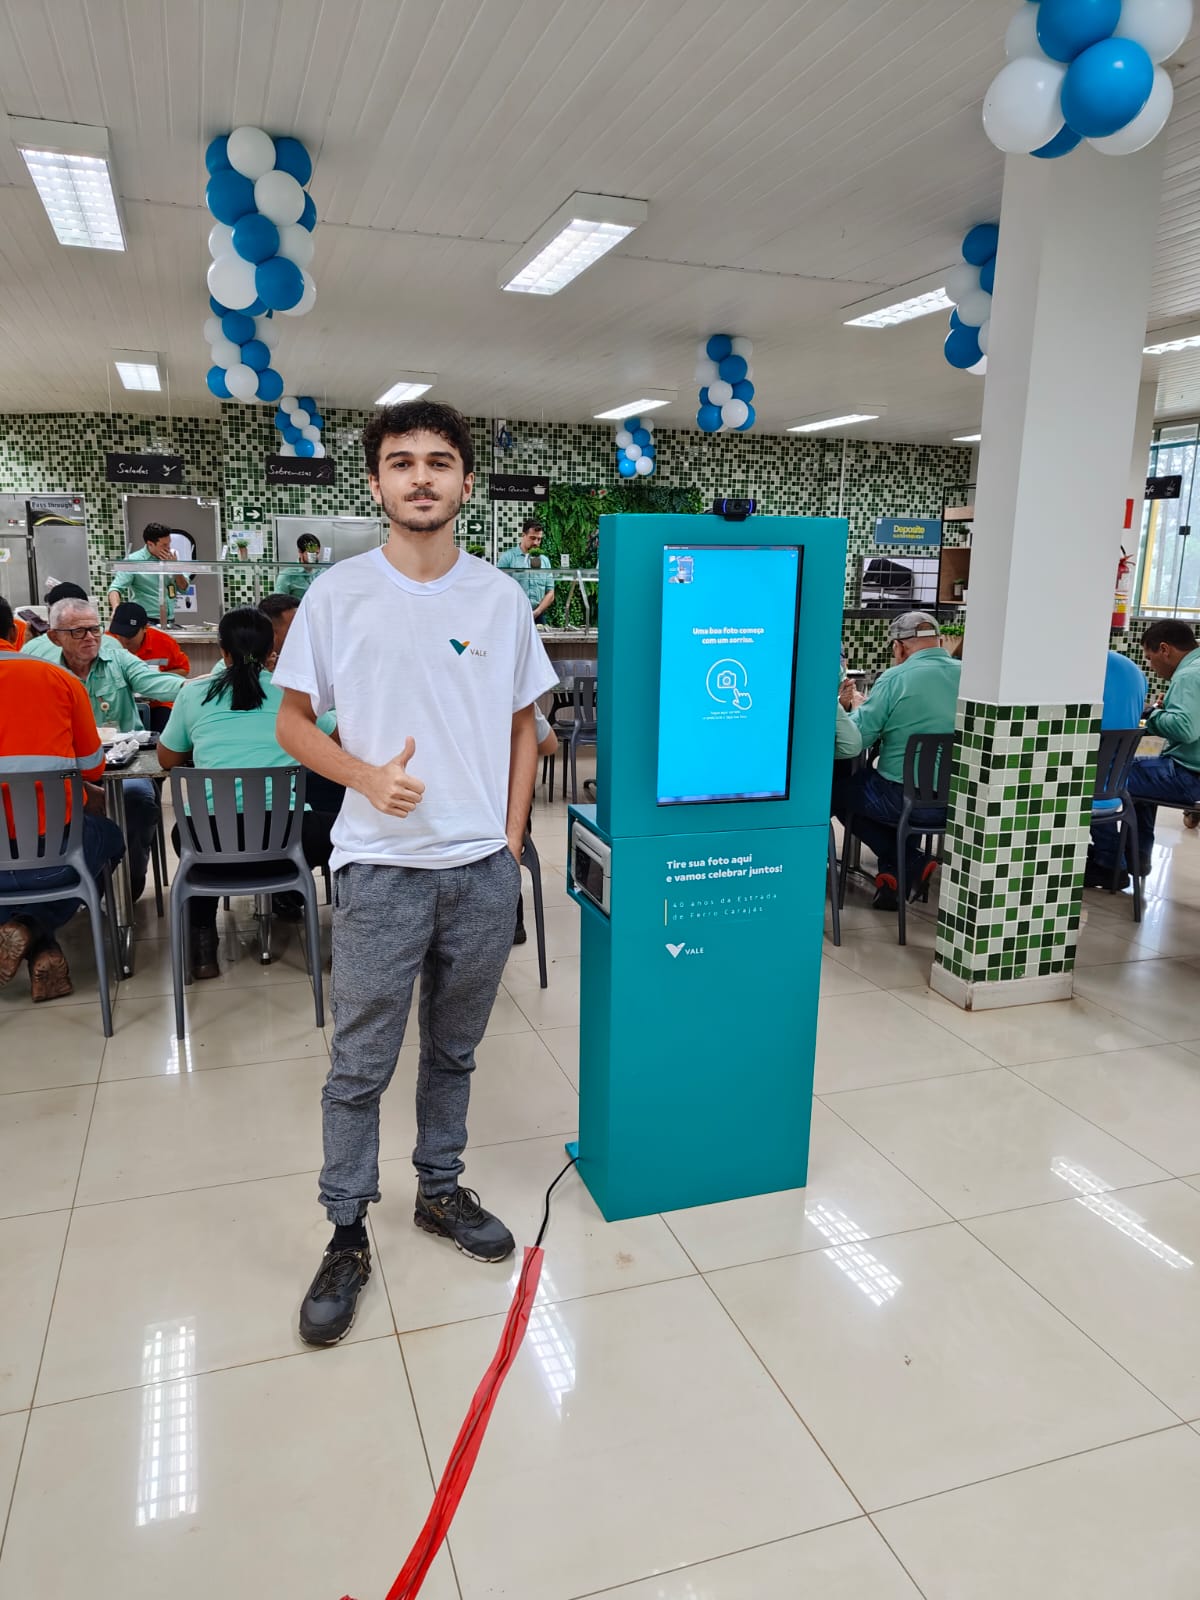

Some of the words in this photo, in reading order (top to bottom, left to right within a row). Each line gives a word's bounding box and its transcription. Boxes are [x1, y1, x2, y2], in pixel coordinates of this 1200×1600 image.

[116, 462, 149, 475] Saladas
[692, 627, 709, 635] Uma
[709, 626, 723, 635] boa
[723, 626, 739, 635] foto
[739, 627, 765, 636] começa
[702, 637, 717, 645] com
[470, 648, 489, 657] VALE
[666, 860, 687, 870] Tire
[688, 859, 706, 868] sua
[707, 856, 730, 867] foto
[731, 853, 753, 866] aqui
[666, 875, 673, 883] e
[674, 871, 707, 882] vamos
[708, 867, 748, 879] celebrar
[748, 864, 783, 878] juntos!
[737, 893, 777, 903] Estrada
[672, 913, 685, 921] de
[690, 911, 718, 919] Ferro
[684, 947, 705, 956] VALE
